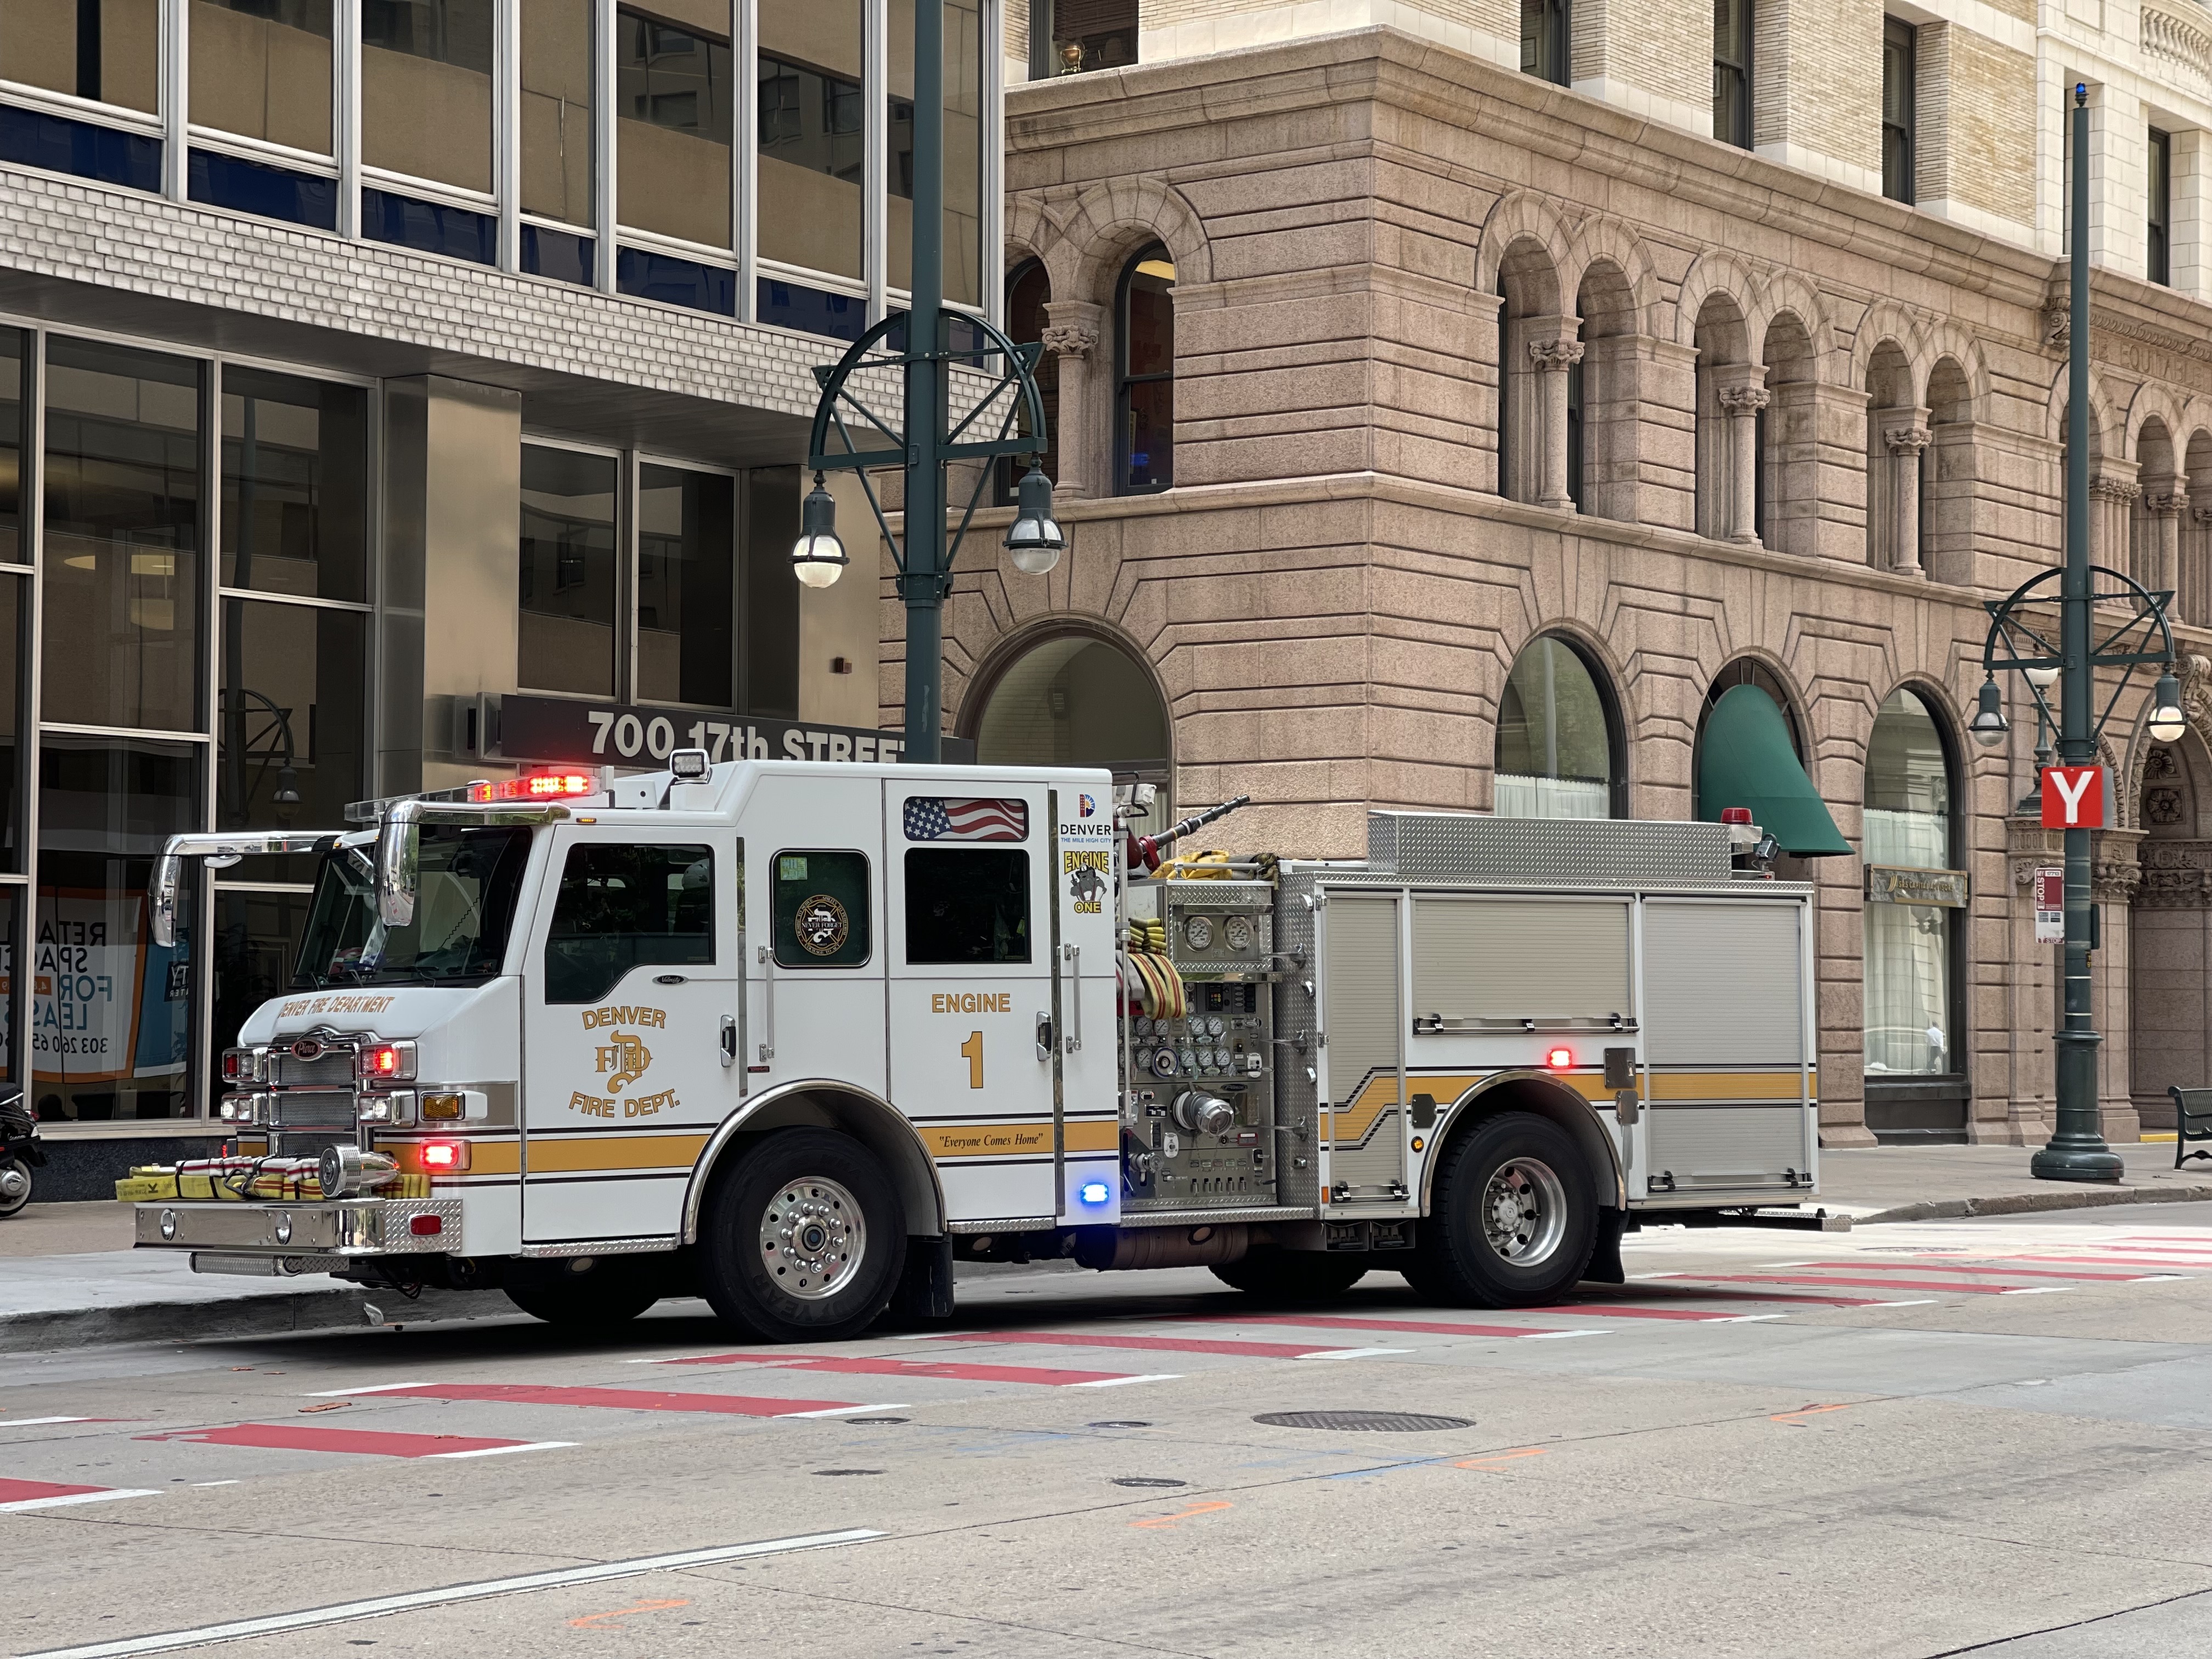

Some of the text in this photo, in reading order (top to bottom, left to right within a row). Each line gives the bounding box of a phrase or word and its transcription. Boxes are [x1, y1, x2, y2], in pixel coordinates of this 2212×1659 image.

[589, 711, 905, 763] 700 17th STREE
[2050, 770, 2095, 823] Y
[1060, 824, 1111, 835] DENVER
[1063, 851, 1109, 876] ENGINE
[1909, 881, 1929, 890] CAPITAL
[1930, 882, 1953, 892] ADVISORS
[1074, 901, 1101, 913] ONE
[277, 996, 395, 1019] DENVER FIRE DEPARTMENT
[932, 994, 1011, 1013] ENGINE
[582, 1006, 666, 1030] DENVER
[297, 1042, 315, 1056] Pierce
[961, 1031, 984, 1089] 1
[568, 1088, 680, 1118] FIRE DEPT.
[984, 1135, 1011, 1147] Comes
